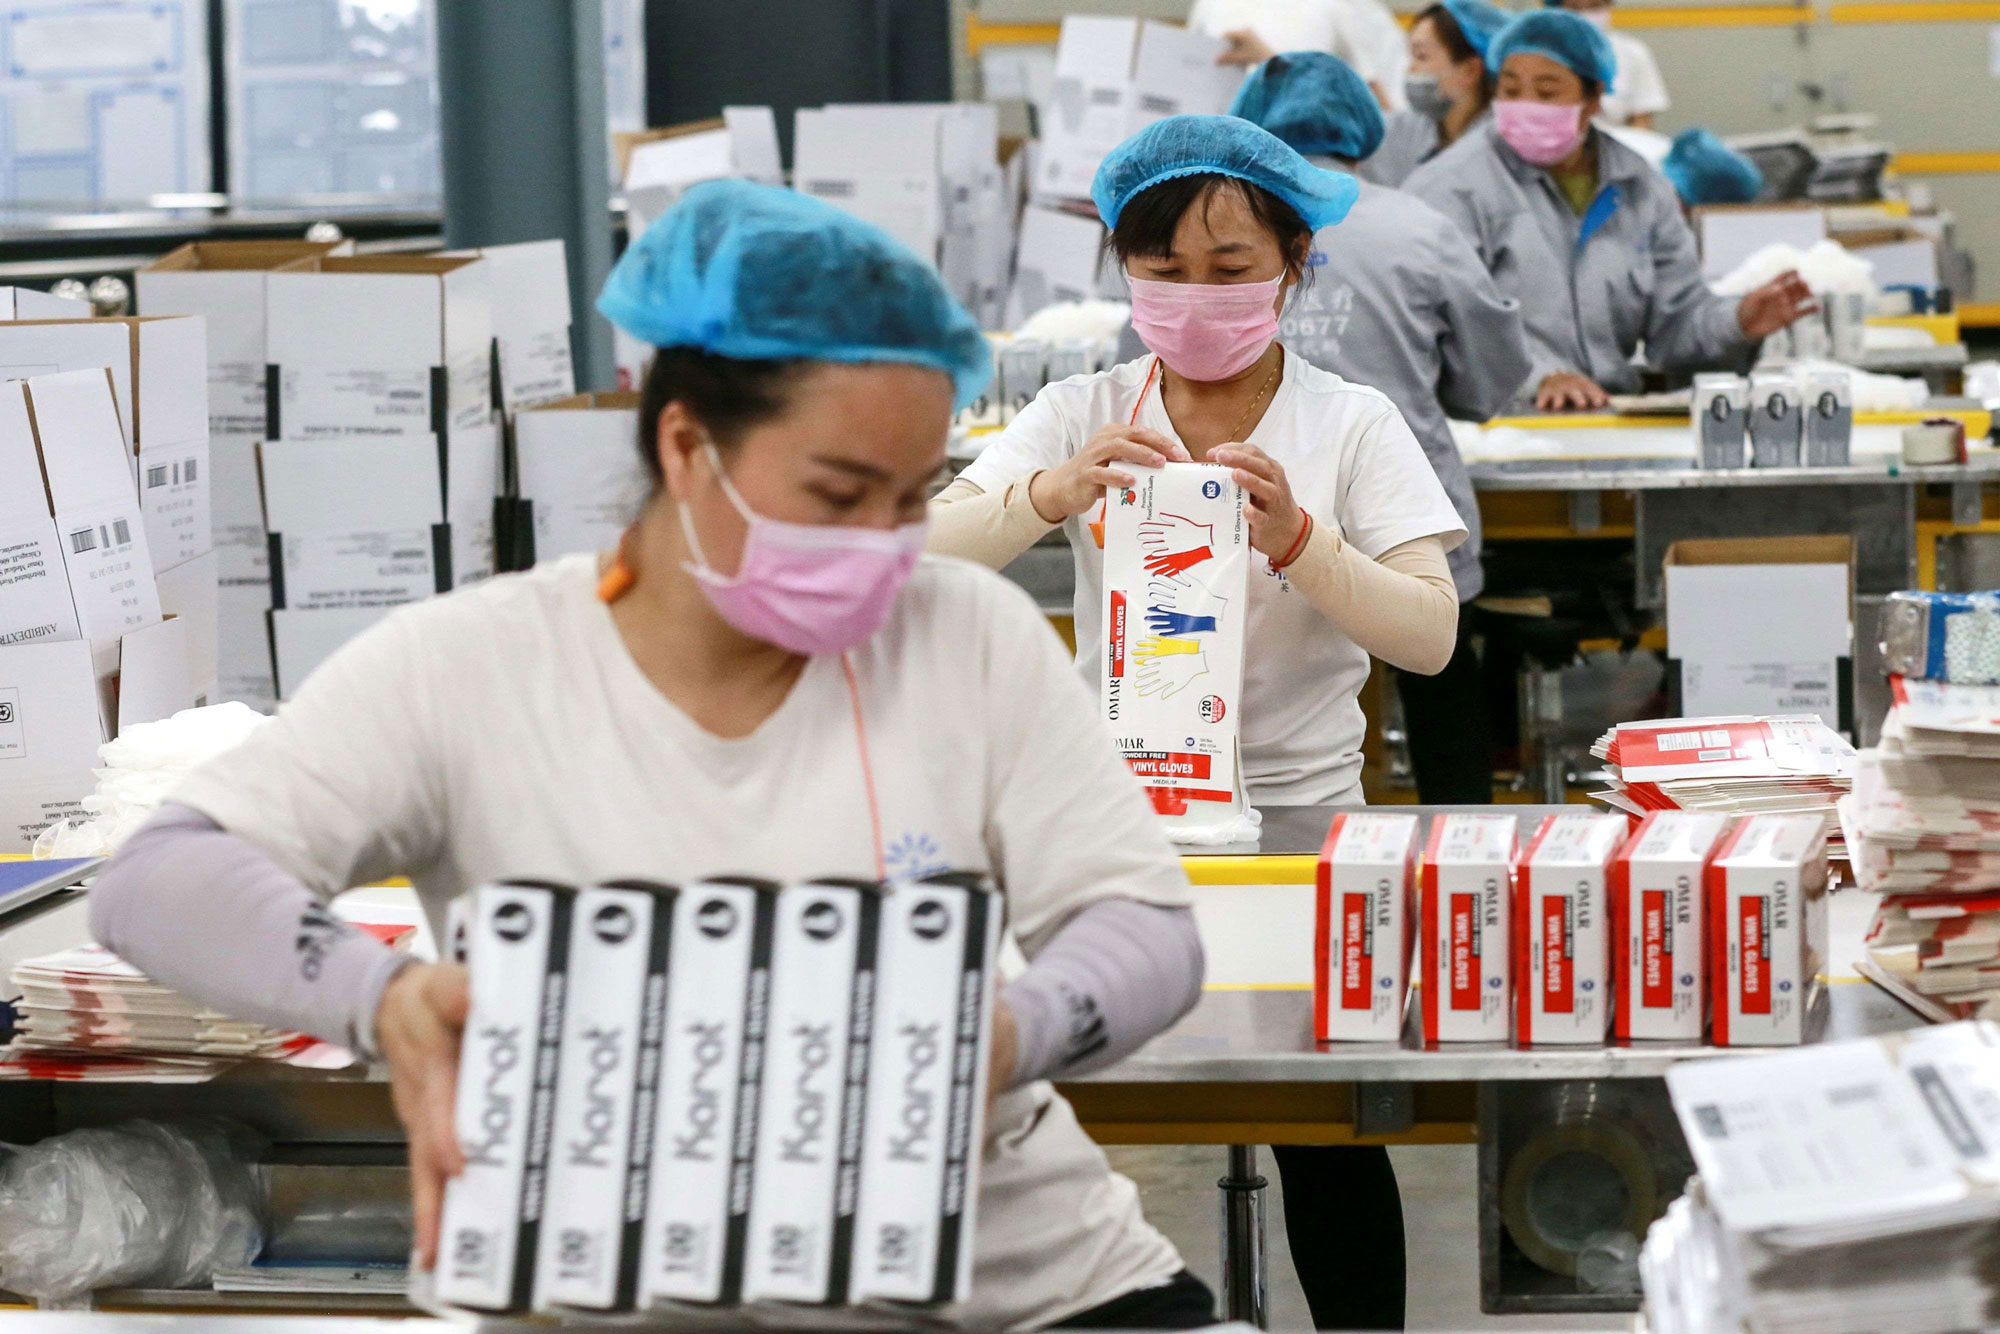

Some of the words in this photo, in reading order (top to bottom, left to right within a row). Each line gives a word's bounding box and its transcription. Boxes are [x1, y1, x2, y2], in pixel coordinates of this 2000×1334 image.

[1116, 605, 1125, 636] GLOVES
[1115, 638, 1124, 661] VINYL
[1108, 679, 1120, 721] OMAR
[1201, 700, 1212, 717] 120
[1132, 761, 1157, 772] VINYL
[1159, 762, 1194, 774] GLOVES
[1149, 752, 1167, 760] FREE
[1376, 878, 1391, 927] OMAR
[1485, 878, 1499, 927] OMAR
[1577, 880, 1591, 929] OMAR
[1676, 875, 1690, 924] OMAR
[1774, 880, 1788, 929] OMAR
[1347, 912, 1361, 944] VINYL
[1455, 912, 1469, 944] VINYL
[1547, 915, 1561, 947] VINYL
[1647, 909, 1660, 942] VINYL
[1744, 915, 1758, 948] VINYL
[1346, 946, 1361, 990] GLOVES
[1455, 946, 1469, 990] GLOVES
[1547, 949, 1561, 992] GLOVES
[1647, 944, 1661, 987] GLOVES
[1744, 949, 1759, 993] GLOVES
[464, 1024, 521, 1167] Karat
[566, 1024, 623, 1167] Karat
[672, 1018, 727, 1161] Karat
[779, 1019, 832, 1162] Karat
[886, 1019, 940, 1162] Karat
